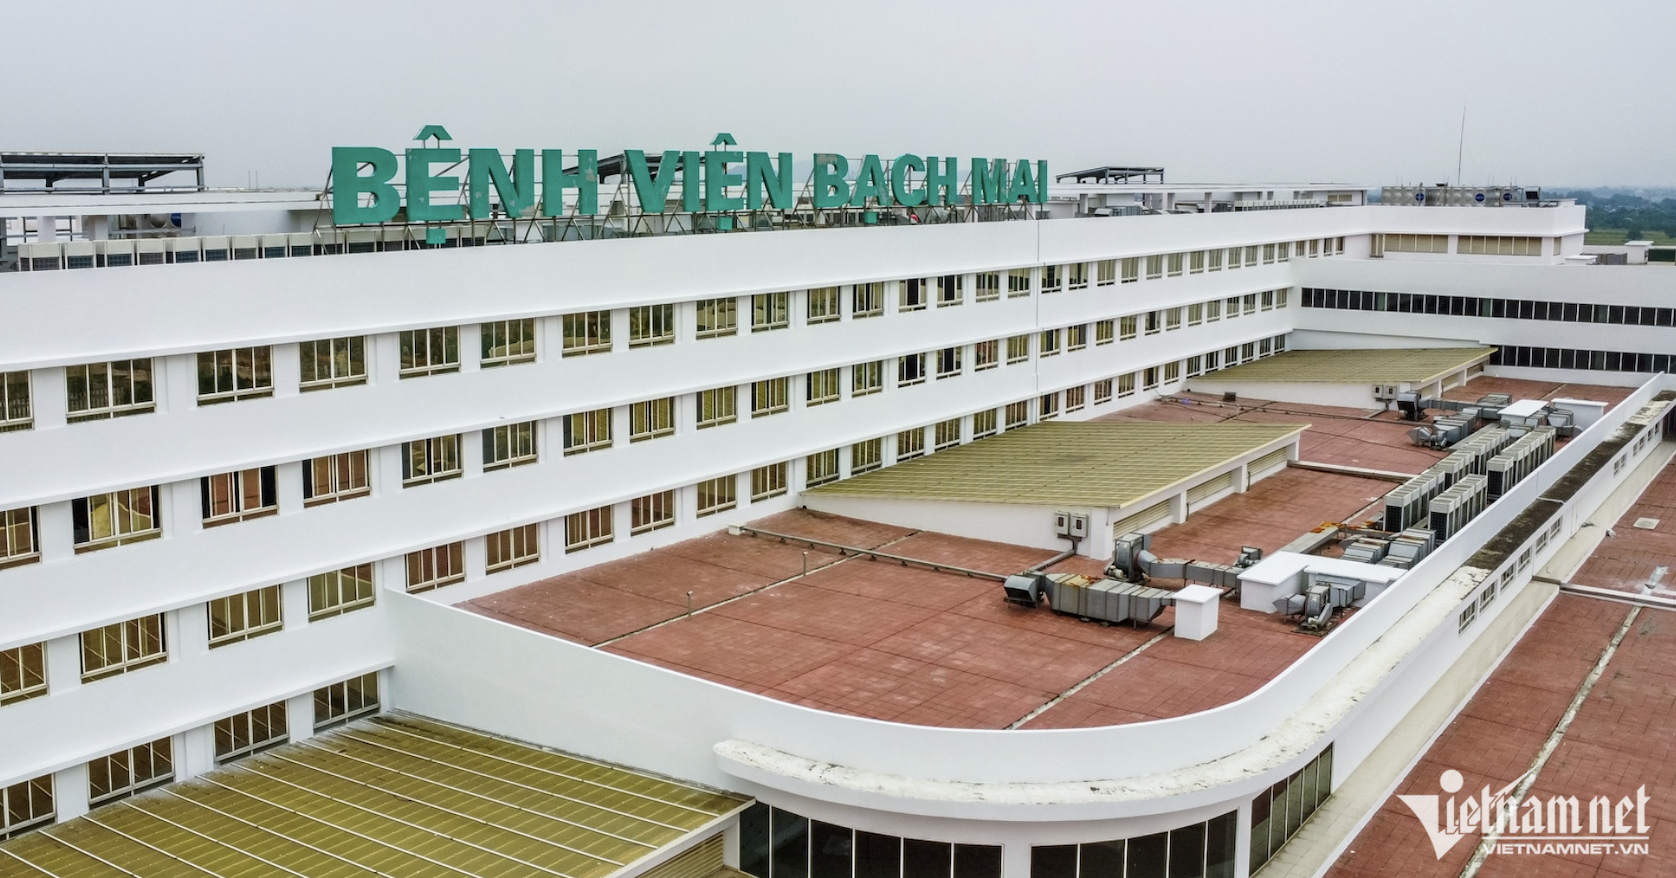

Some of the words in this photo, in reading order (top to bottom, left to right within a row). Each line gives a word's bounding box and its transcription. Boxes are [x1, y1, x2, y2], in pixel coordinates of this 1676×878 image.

[332, 125, 598, 245] BỆNH
[623, 132, 793, 231] VIỆN
[813, 153, 957, 224] BẠCH
[971, 157, 1048, 204] MAI
